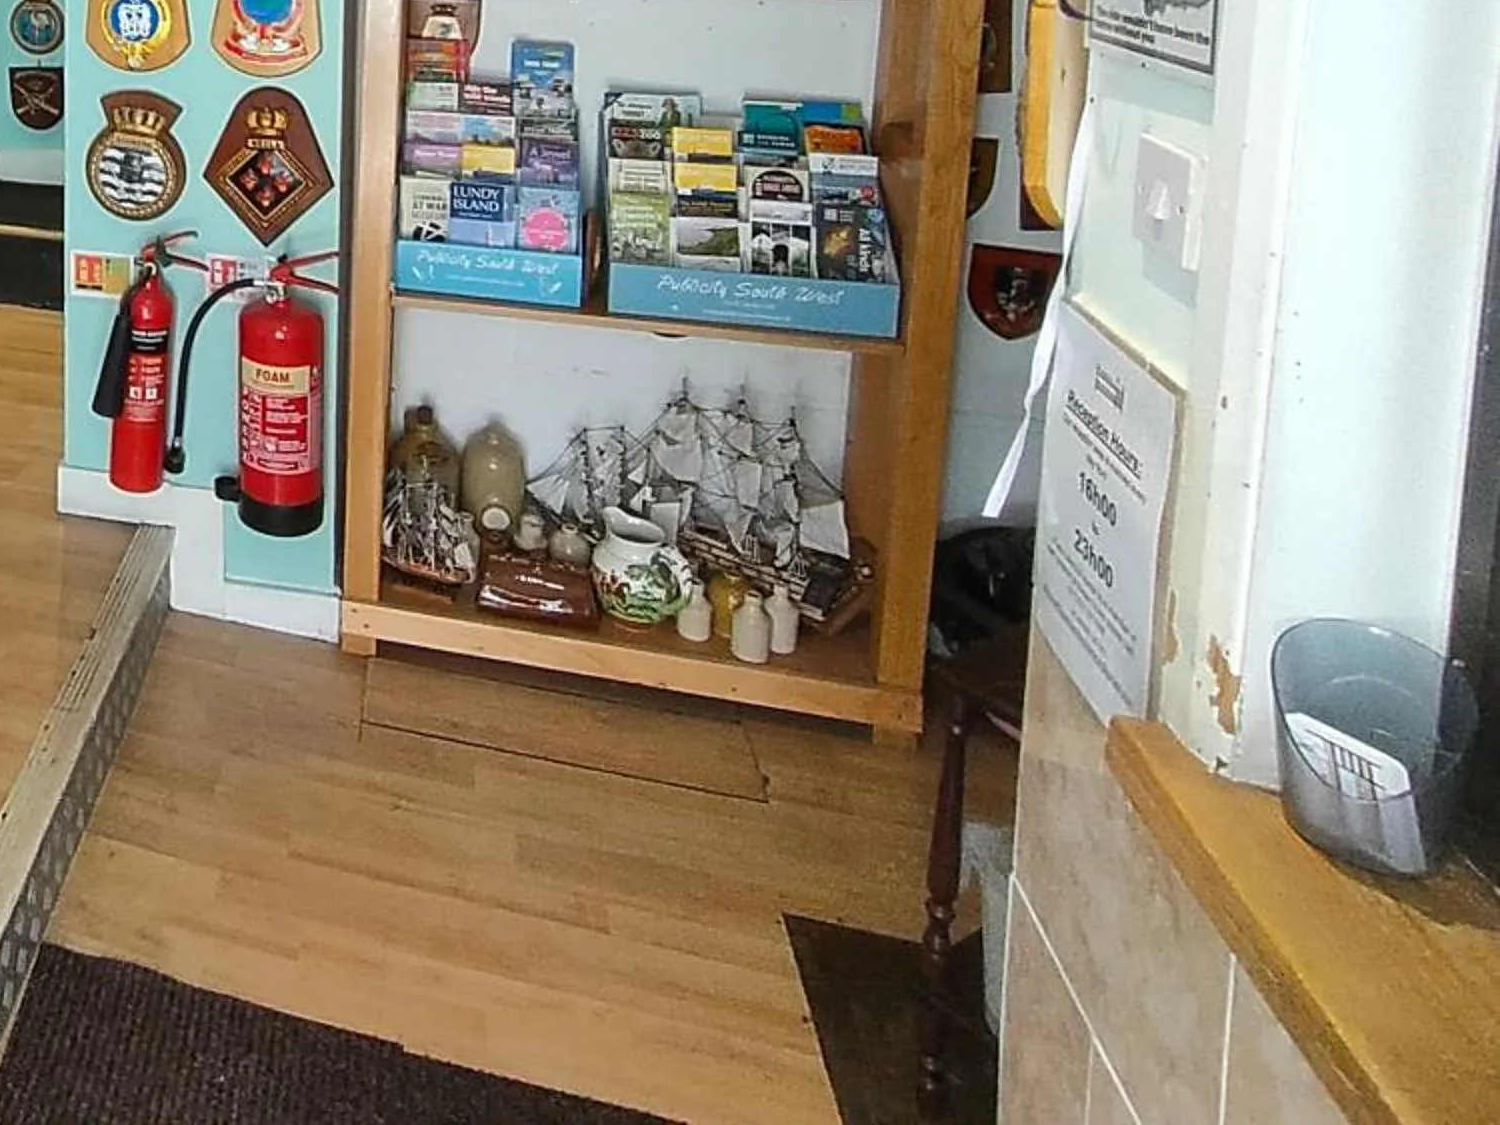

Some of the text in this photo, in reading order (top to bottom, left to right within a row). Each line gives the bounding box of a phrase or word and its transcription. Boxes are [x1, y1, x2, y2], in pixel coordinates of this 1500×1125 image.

[453, 185, 500, 200] LUNDY
[453, 198, 500, 212] ISLAND
[417, 248, 471, 269] Publicity
[475, 254, 516, 270] South
[656, 275, 728, 297] Publicity
[734, 281, 788, 301] South
[795, 287, 844, 305] West
[255, 369, 290, 383] FOAM
[1067, 388, 1110, 441] Reception
[1078, 471, 1117, 527] 16h00
[1073, 528, 1113, 588] 23h00
